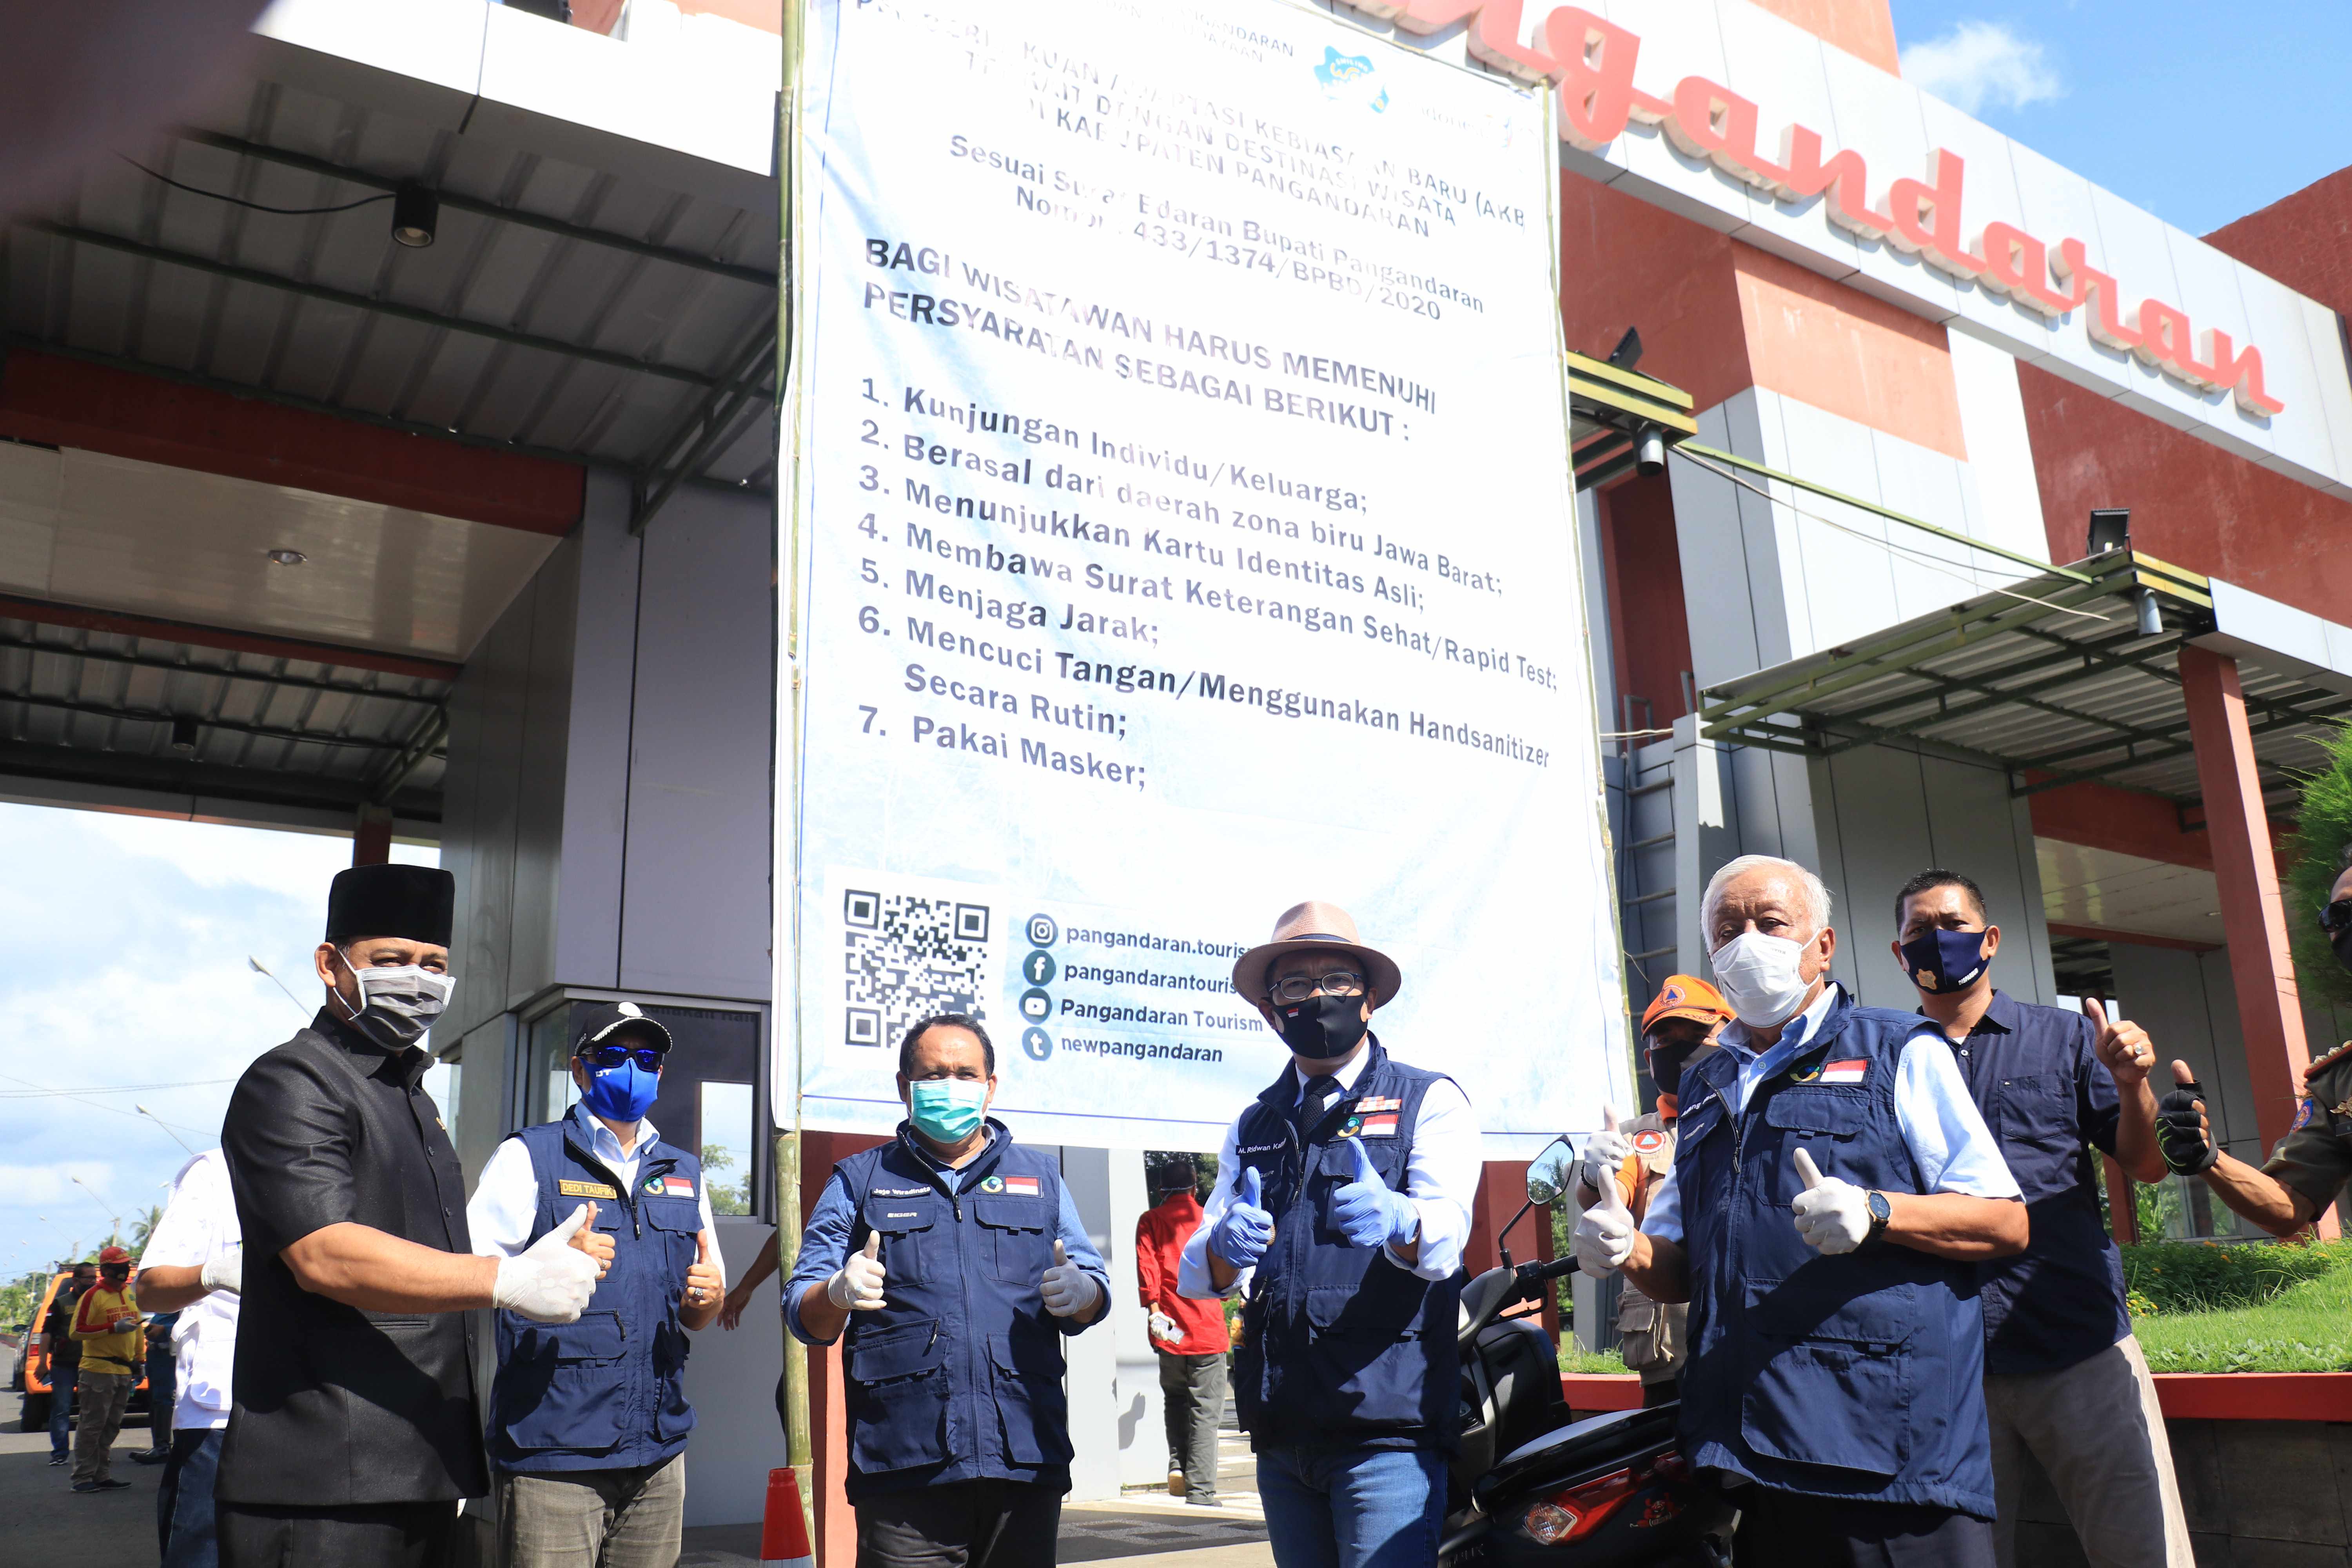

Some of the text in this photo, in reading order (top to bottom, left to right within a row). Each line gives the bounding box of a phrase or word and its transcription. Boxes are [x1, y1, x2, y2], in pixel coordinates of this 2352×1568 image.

[949, 135, 1044, 185] Sesuai
[1139, 193, 1232, 237] Edaran
[1243, 220, 1323, 261] Bupati
[1333, 248, 1483, 314] Pangandaran
[1236, 161, 1429, 238] PANGANDARAN
[1368, 180, 1456, 227] WISATA
[1408, 167, 1466, 205] BARU
[1133, 221, 1440, 320] 433/1374/BPBD/2020
[864, 281, 1102, 370] PERSYARATAN
[1115, 354, 1252, 406] SEBAGAI
[1264, 388, 1394, 436] BERIKUT
[866, 238, 1435, 415] BAGI WISATAWAN HARUS MEMENUHI
[862, 377, 1367, 516] 1. Kunjungan Individu/Keluarga;
[859, 465, 1423, 615] 3. Menunjukkan Kartu Identitas Asli;
[861, 419, 1501, 598] 2. Berasal dari daerah zona biru Jawa Barat;
[858, 513, 1557, 694] 4. Membawa Surat Keterangan Sehat/Rapid Test;
[860, 557, 1158, 649] 5. Menjaga Jarak;
[858, 606, 1549, 768] 6. Mencuci Tangan/Menggunakan Handsanitizer
[904, 663, 1126, 741] Secara Rutin;
[858, 704, 1145, 792] 7. Pakai Masker;
[1064, 964, 1237, 994] pangandarantouris
[1067, 927, 1253, 959] pangandaran.touris
[1061, 998, 1263, 1031] Pangandaran Tourism
[1062, 1037, 1222, 1062] newpangandaran
[563, 1183, 613, 1196] DEDI TAUFIK
[892, 1186, 931, 1195] Wiradinata
[1247, 1145, 1270, 1153] Ridwan
